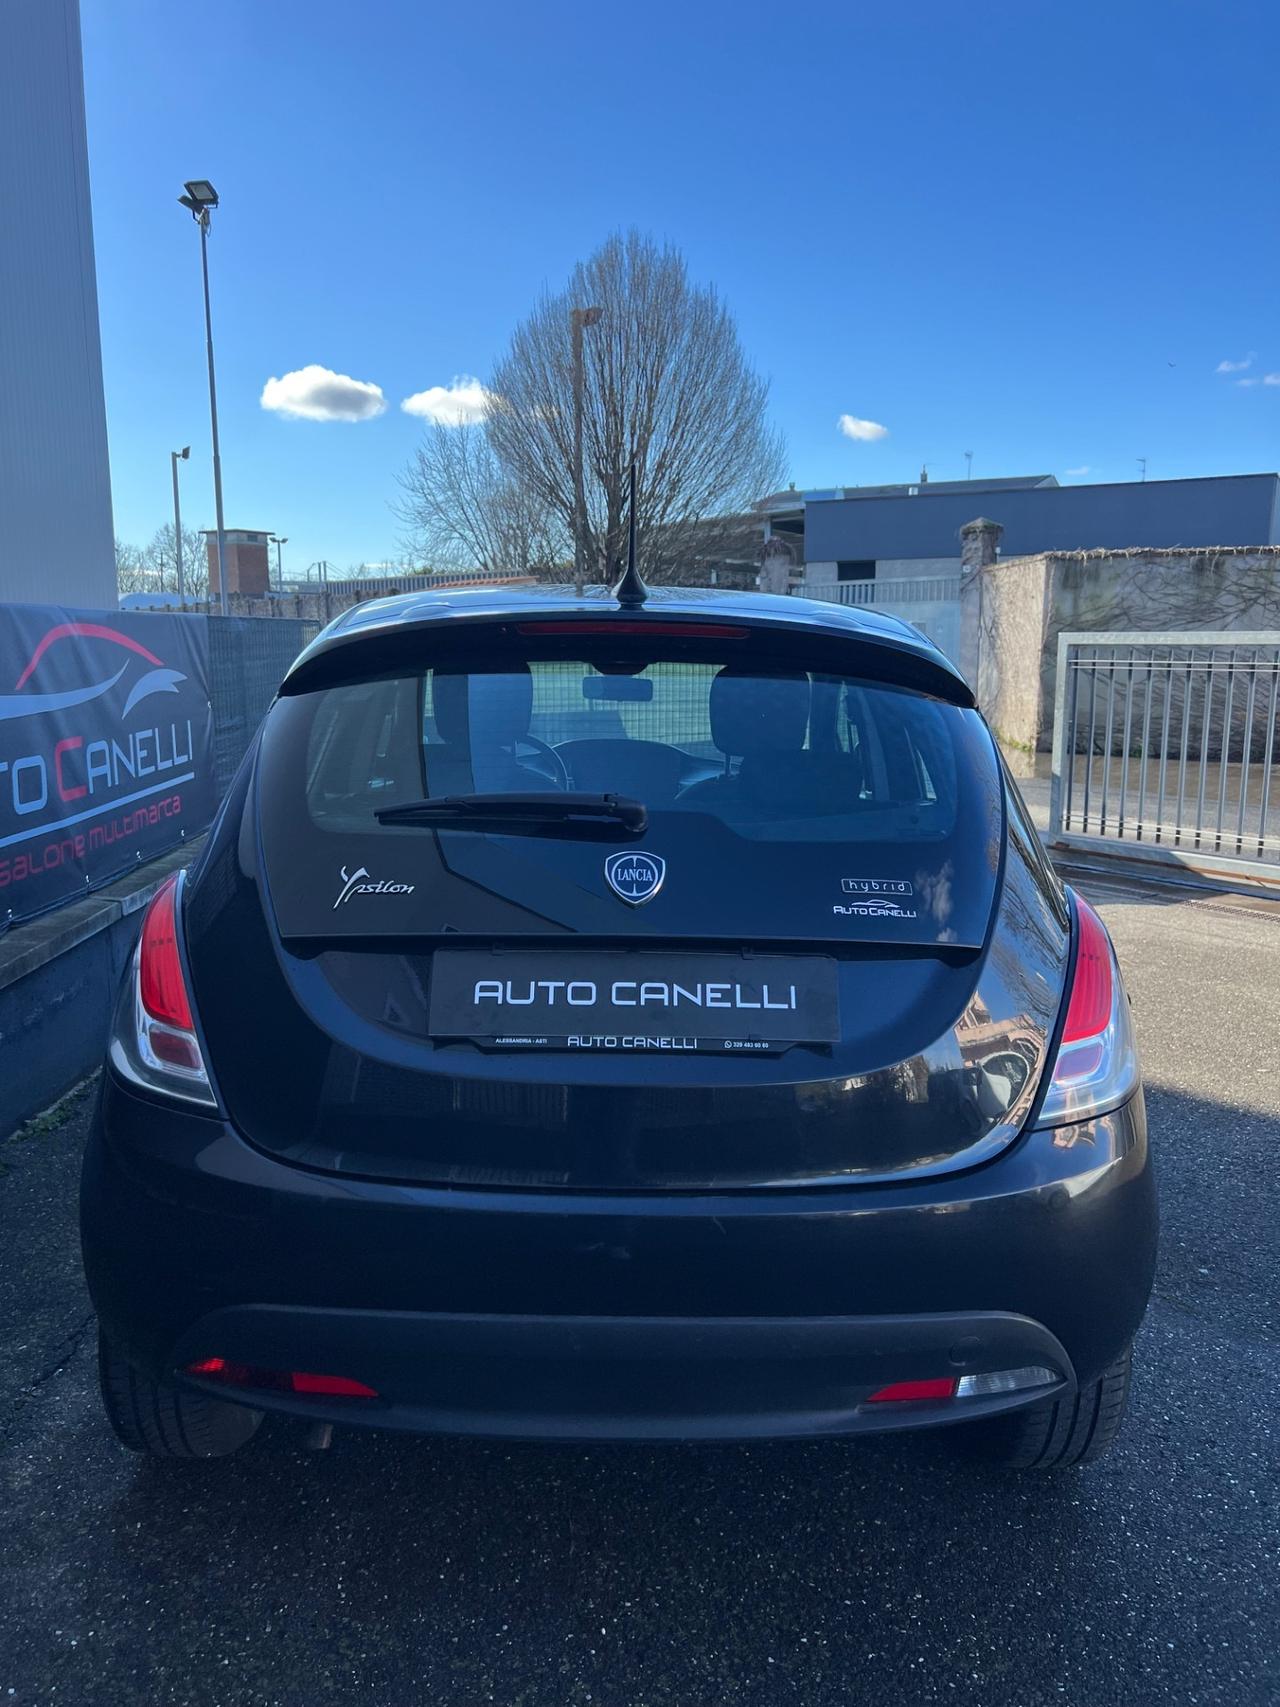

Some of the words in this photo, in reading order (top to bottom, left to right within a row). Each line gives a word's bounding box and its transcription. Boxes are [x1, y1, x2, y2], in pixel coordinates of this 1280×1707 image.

[617, 868, 653, 882] LANCIA
[333, 865, 416, 909] Ypsilon
[848, 879, 905, 893] hybrid
[473, 980, 597, 1006] AUTO
[610, 981, 797, 1010] CANELLI
[567, 1035, 617, 1047] AUTO
[622, 1036, 698, 1049] CANELLI
